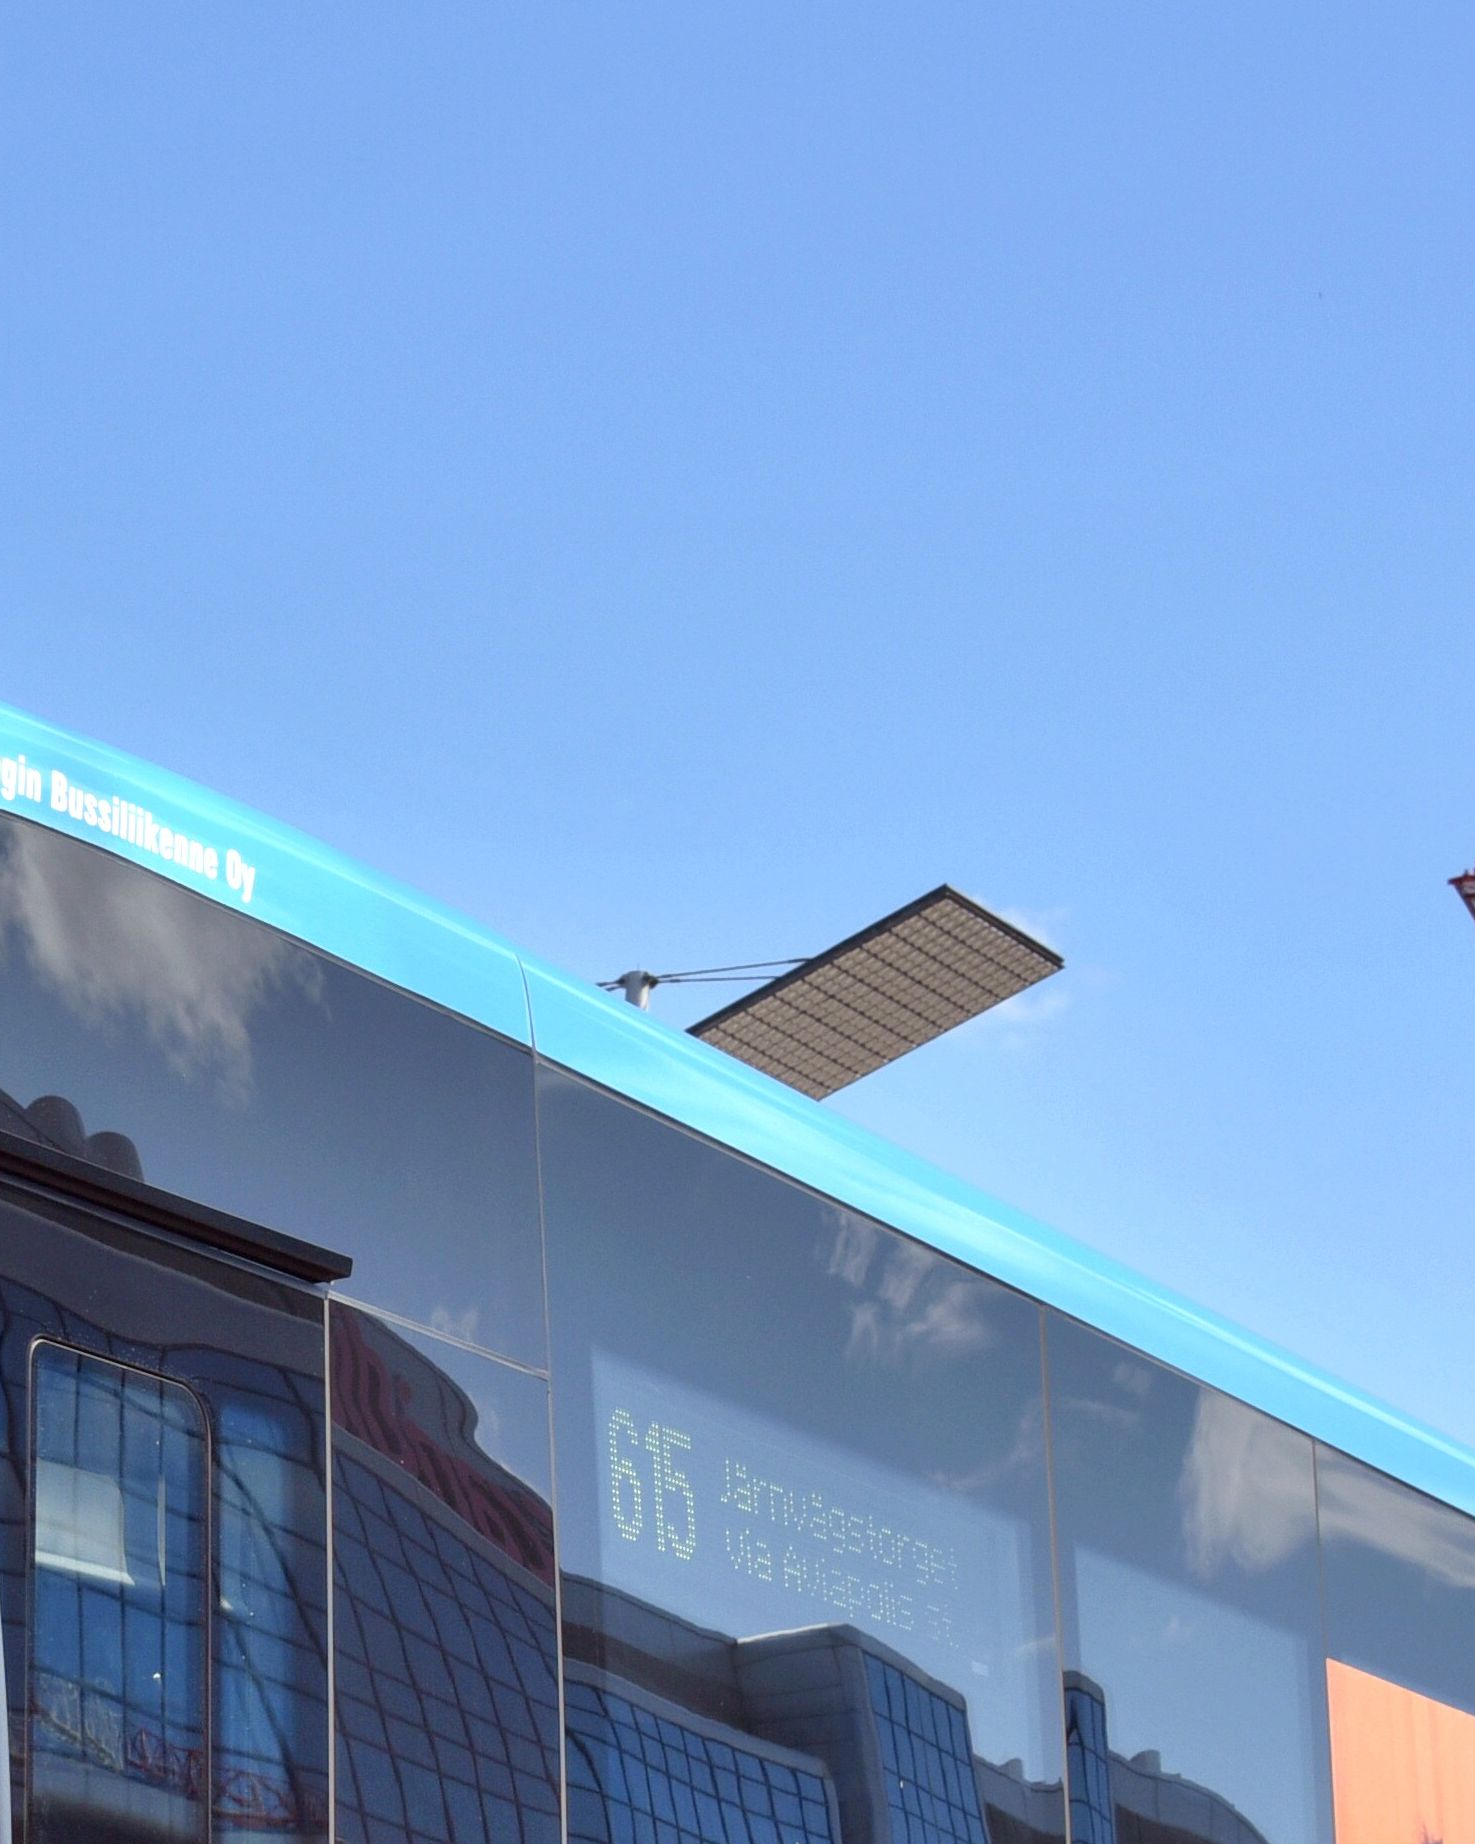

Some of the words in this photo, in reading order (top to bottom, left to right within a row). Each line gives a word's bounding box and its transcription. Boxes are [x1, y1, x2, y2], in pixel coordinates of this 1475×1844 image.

[49, 768, 219, 880] Bussiliikenne
[225, 847, 257, 904] Oy
[607, 1407, 697, 1561] 615
[720, 1457, 960, 1591] Järnvägstorget
[725, 1527, 773, 1583] via
[783, 1544, 915, 1632] Aviapolis
